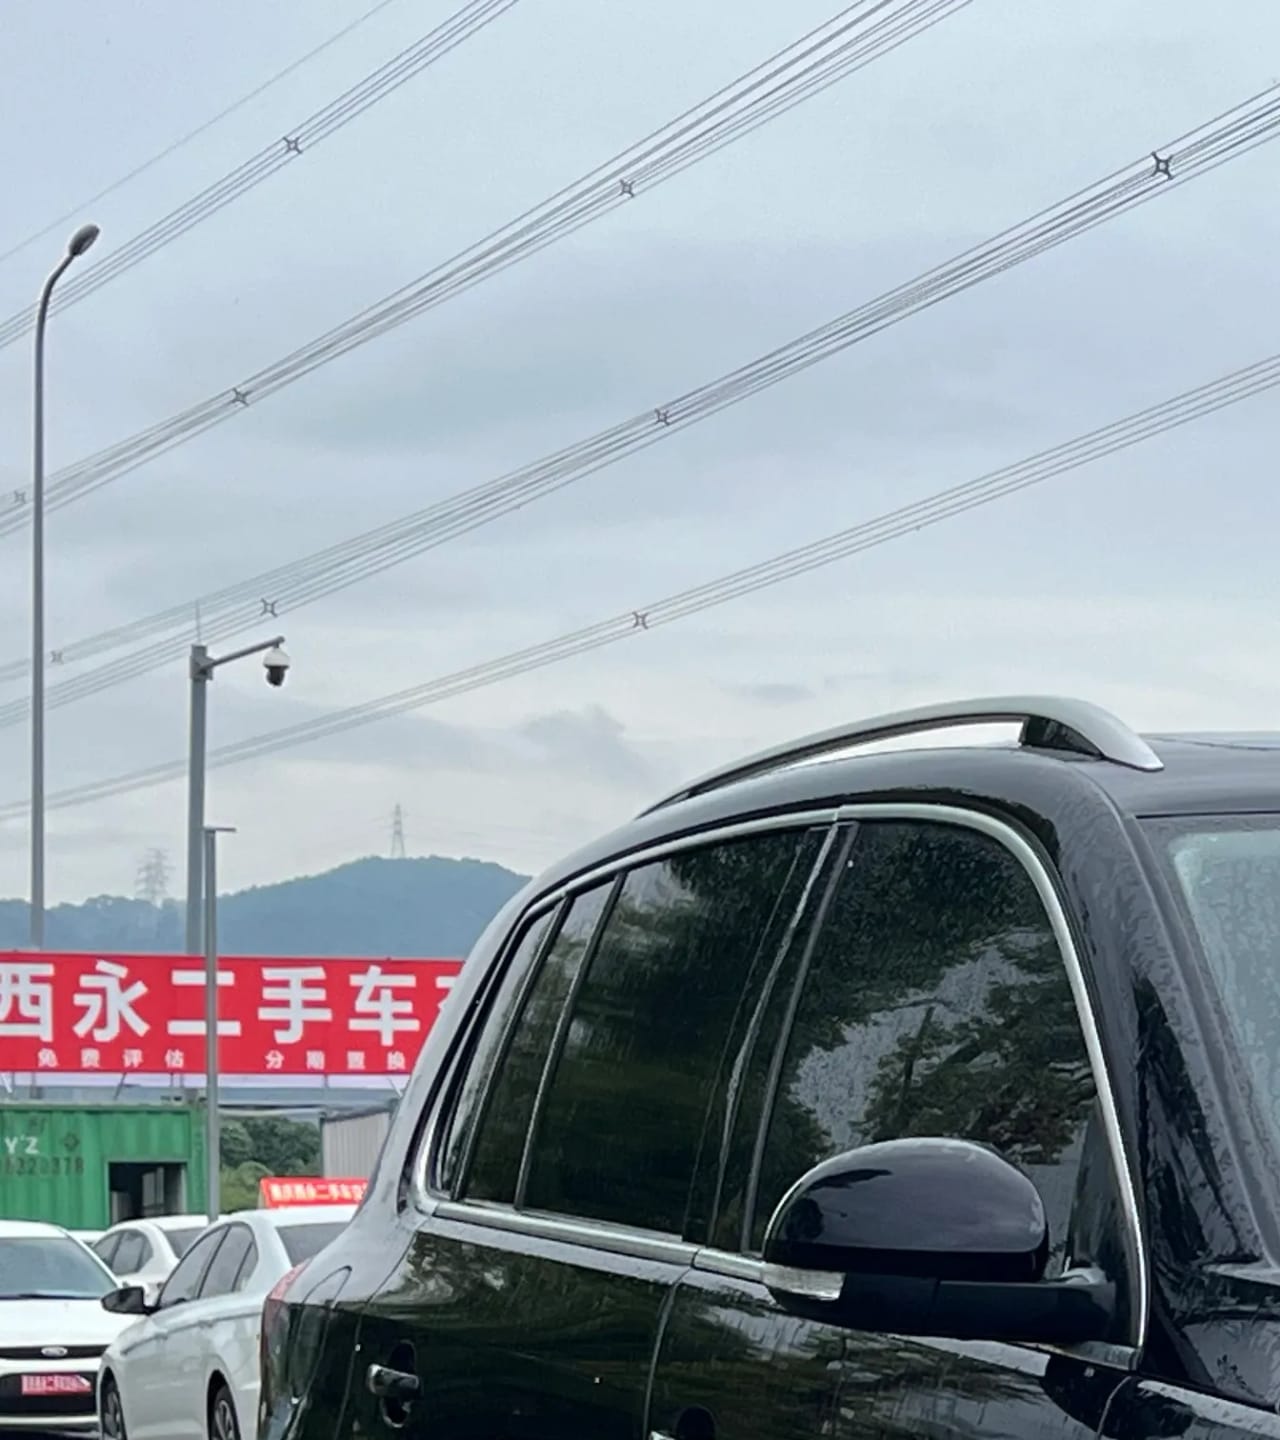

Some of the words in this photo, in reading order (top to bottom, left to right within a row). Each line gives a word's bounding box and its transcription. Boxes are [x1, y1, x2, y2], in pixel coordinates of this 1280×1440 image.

[0, 959, 457, 1046] 西永二手车
